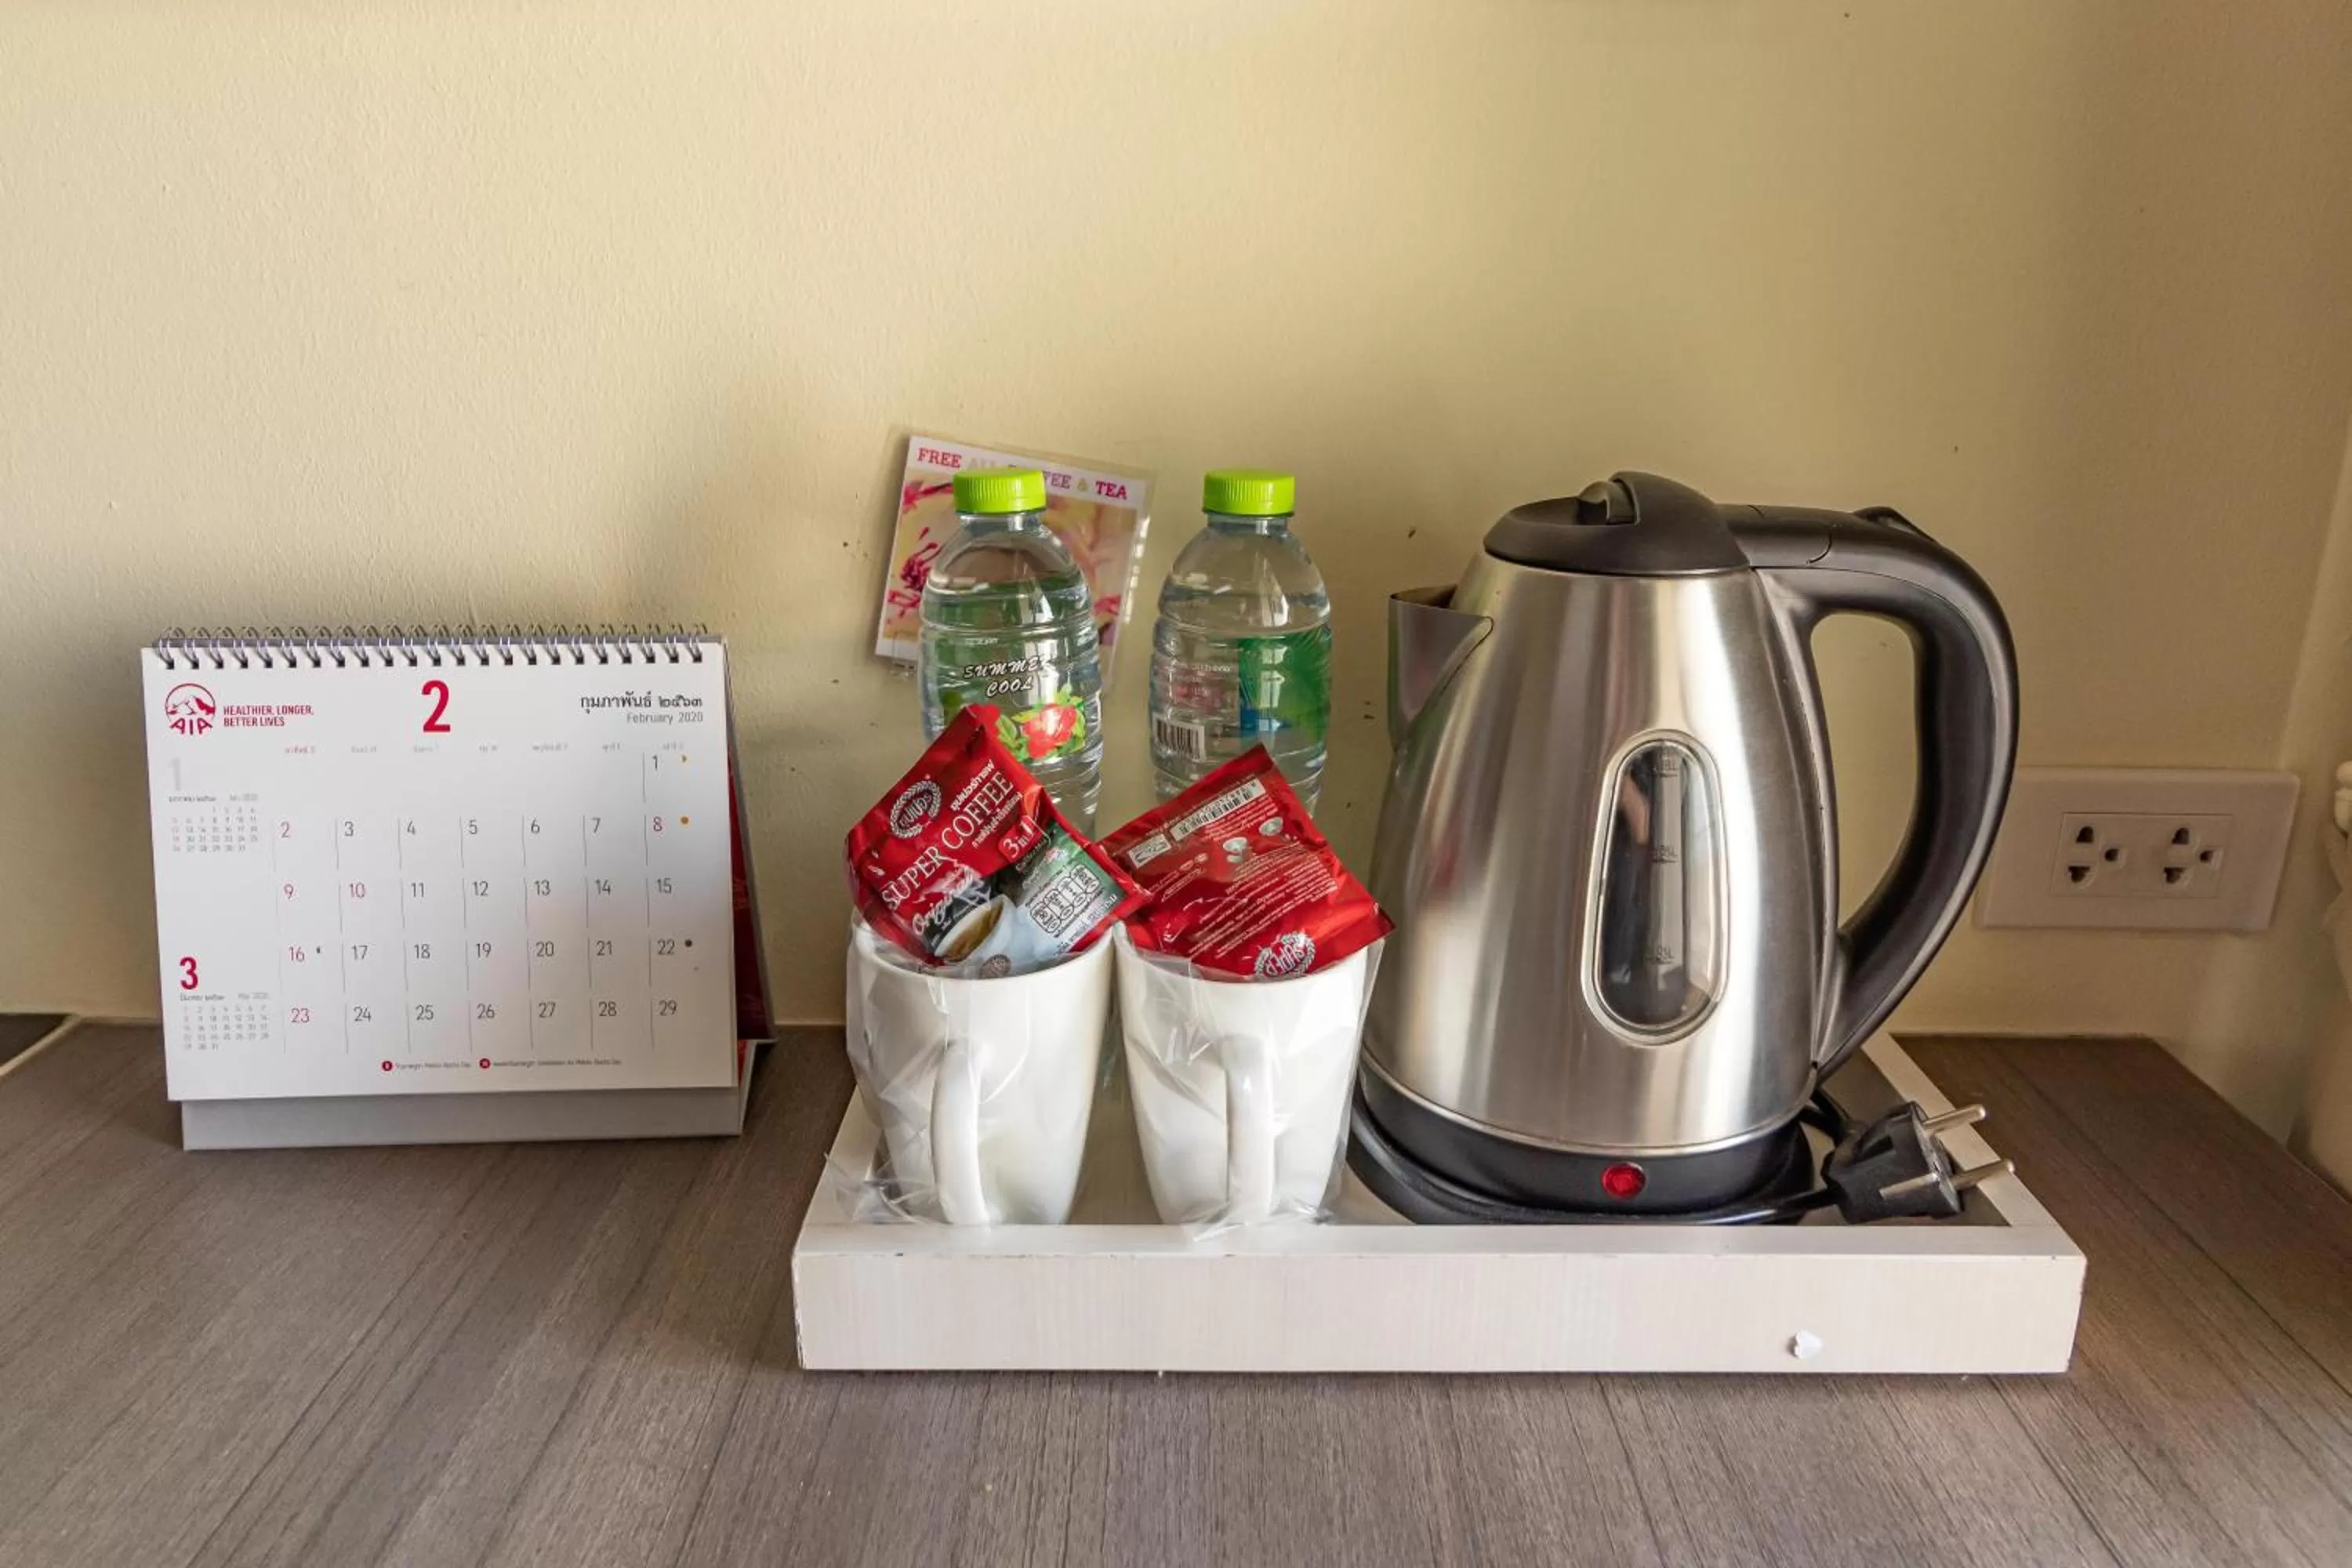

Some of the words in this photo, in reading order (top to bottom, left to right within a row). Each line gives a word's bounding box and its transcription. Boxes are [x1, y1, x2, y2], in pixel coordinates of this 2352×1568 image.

[917, 448, 962, 469] FREE
[1095, 481, 1128, 500] TEA
[964, 656, 1054, 679] SUMME
[985, 676, 1033, 699] COOL
[421, 680, 452, 733] 2
[580, 690, 652, 715] กุมภาพันธ์
[169, 717, 213, 736] AIA
[223, 716, 258, 727] BETTER
[260, 715, 286, 727] LIVES
[626, 711, 673, 725] February
[678, 710, 703, 724] 2020
[652, 754, 658, 771] 1
[280, 821, 290, 838] 2
[344, 821, 354, 837] 3
[406, 819, 416, 835] 4
[468, 818, 478, 835] 5
[531, 818, 540, 834] 6
[592, 817, 601, 834] 7
[653, 816, 662, 833] 8
[882, 846, 946, 911] SUPER
[942, 771, 1014, 850] COFFEE
[283, 883, 294, 900] 9
[349, 882, 366, 899] 10
[411, 882, 424, 898] 11
[473, 880, 489, 897] 12
[534, 879, 552, 897] 13
[595, 879, 612, 895] 14
[656, 877, 673, 895] 15
[289, 946, 305, 962] 16
[351, 945, 368, 960] 17
[413, 943, 430, 960] 18
[476, 942, 492, 958] 19
[535, 940, 555, 958] 20
[596, 940, 613, 956] 21
[657, 938, 676, 956] 22
[180, 956, 198, 990] 3
[291, 1007, 310, 1023] 23
[354, 1006, 372, 1022] 24
[415, 1004, 434, 1021] 25
[477, 1003, 496, 1020] 26
[539, 1001, 557, 1018] 27
[598, 1000, 618, 1017] 28
[659, 1000, 678, 1017] 29
